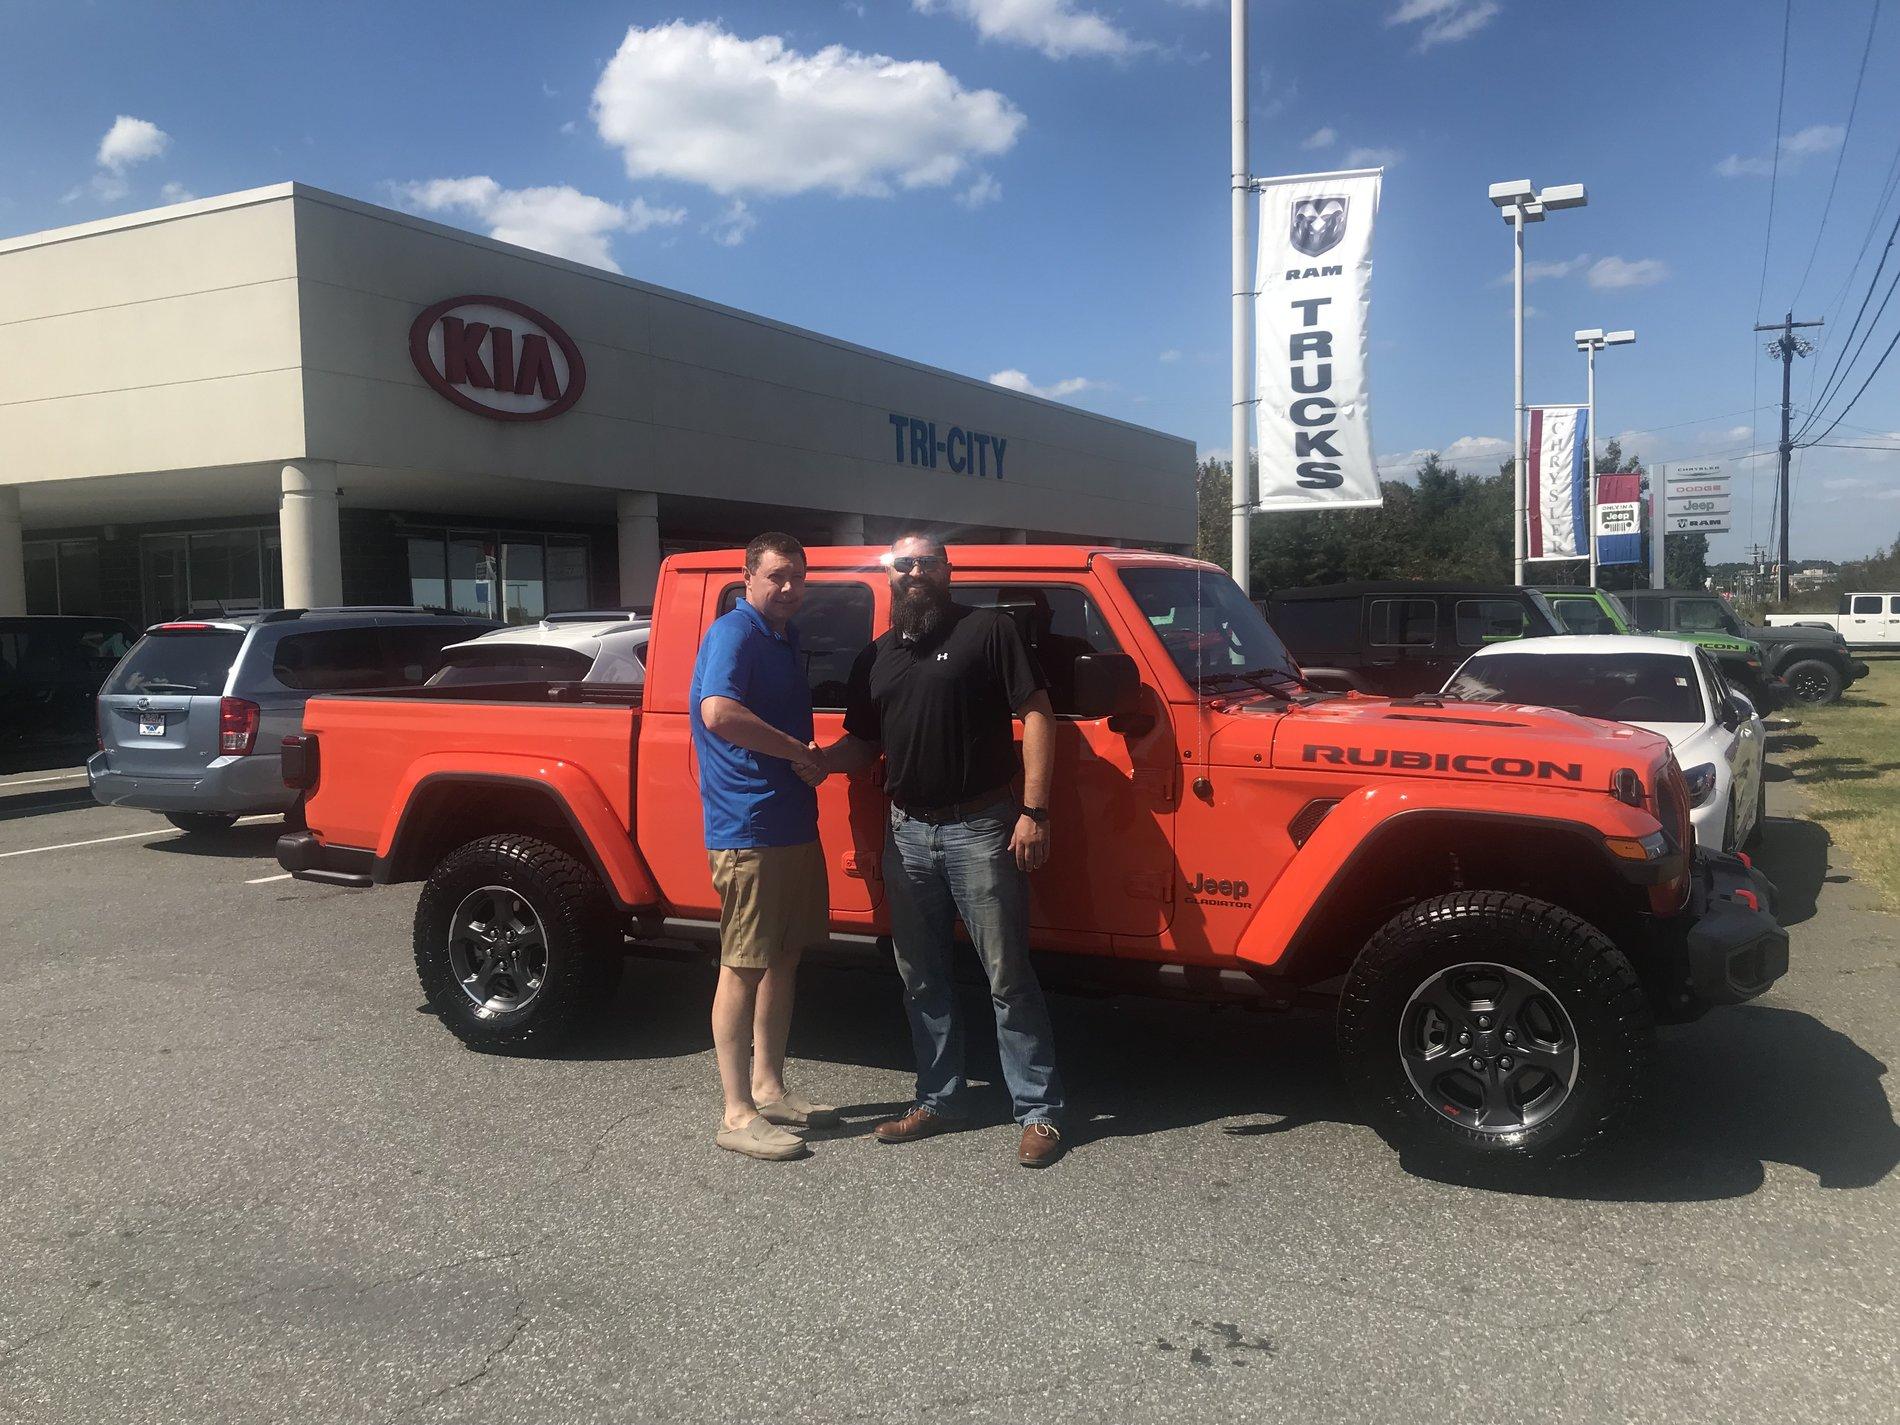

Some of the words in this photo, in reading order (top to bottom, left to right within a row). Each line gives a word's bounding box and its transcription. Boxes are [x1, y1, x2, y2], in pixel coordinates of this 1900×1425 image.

[1285, 265, 1343, 281] RAM
[441, 316, 562, 401] KIA
[1289, 297, 1344, 489] TRUCKS
[889, 413, 1007, 480] TRI-CITY
[1548, 421, 1565, 553] CHRYSLER
[1606, 512, 1630, 520] Jeep
[1683, 501, 1714, 511] Jeep
[1302, 744, 1582, 781] RUBICON
[1187, 873, 1249, 900] Jeep
[1184, 897, 1252, 909] GLADIATOR
